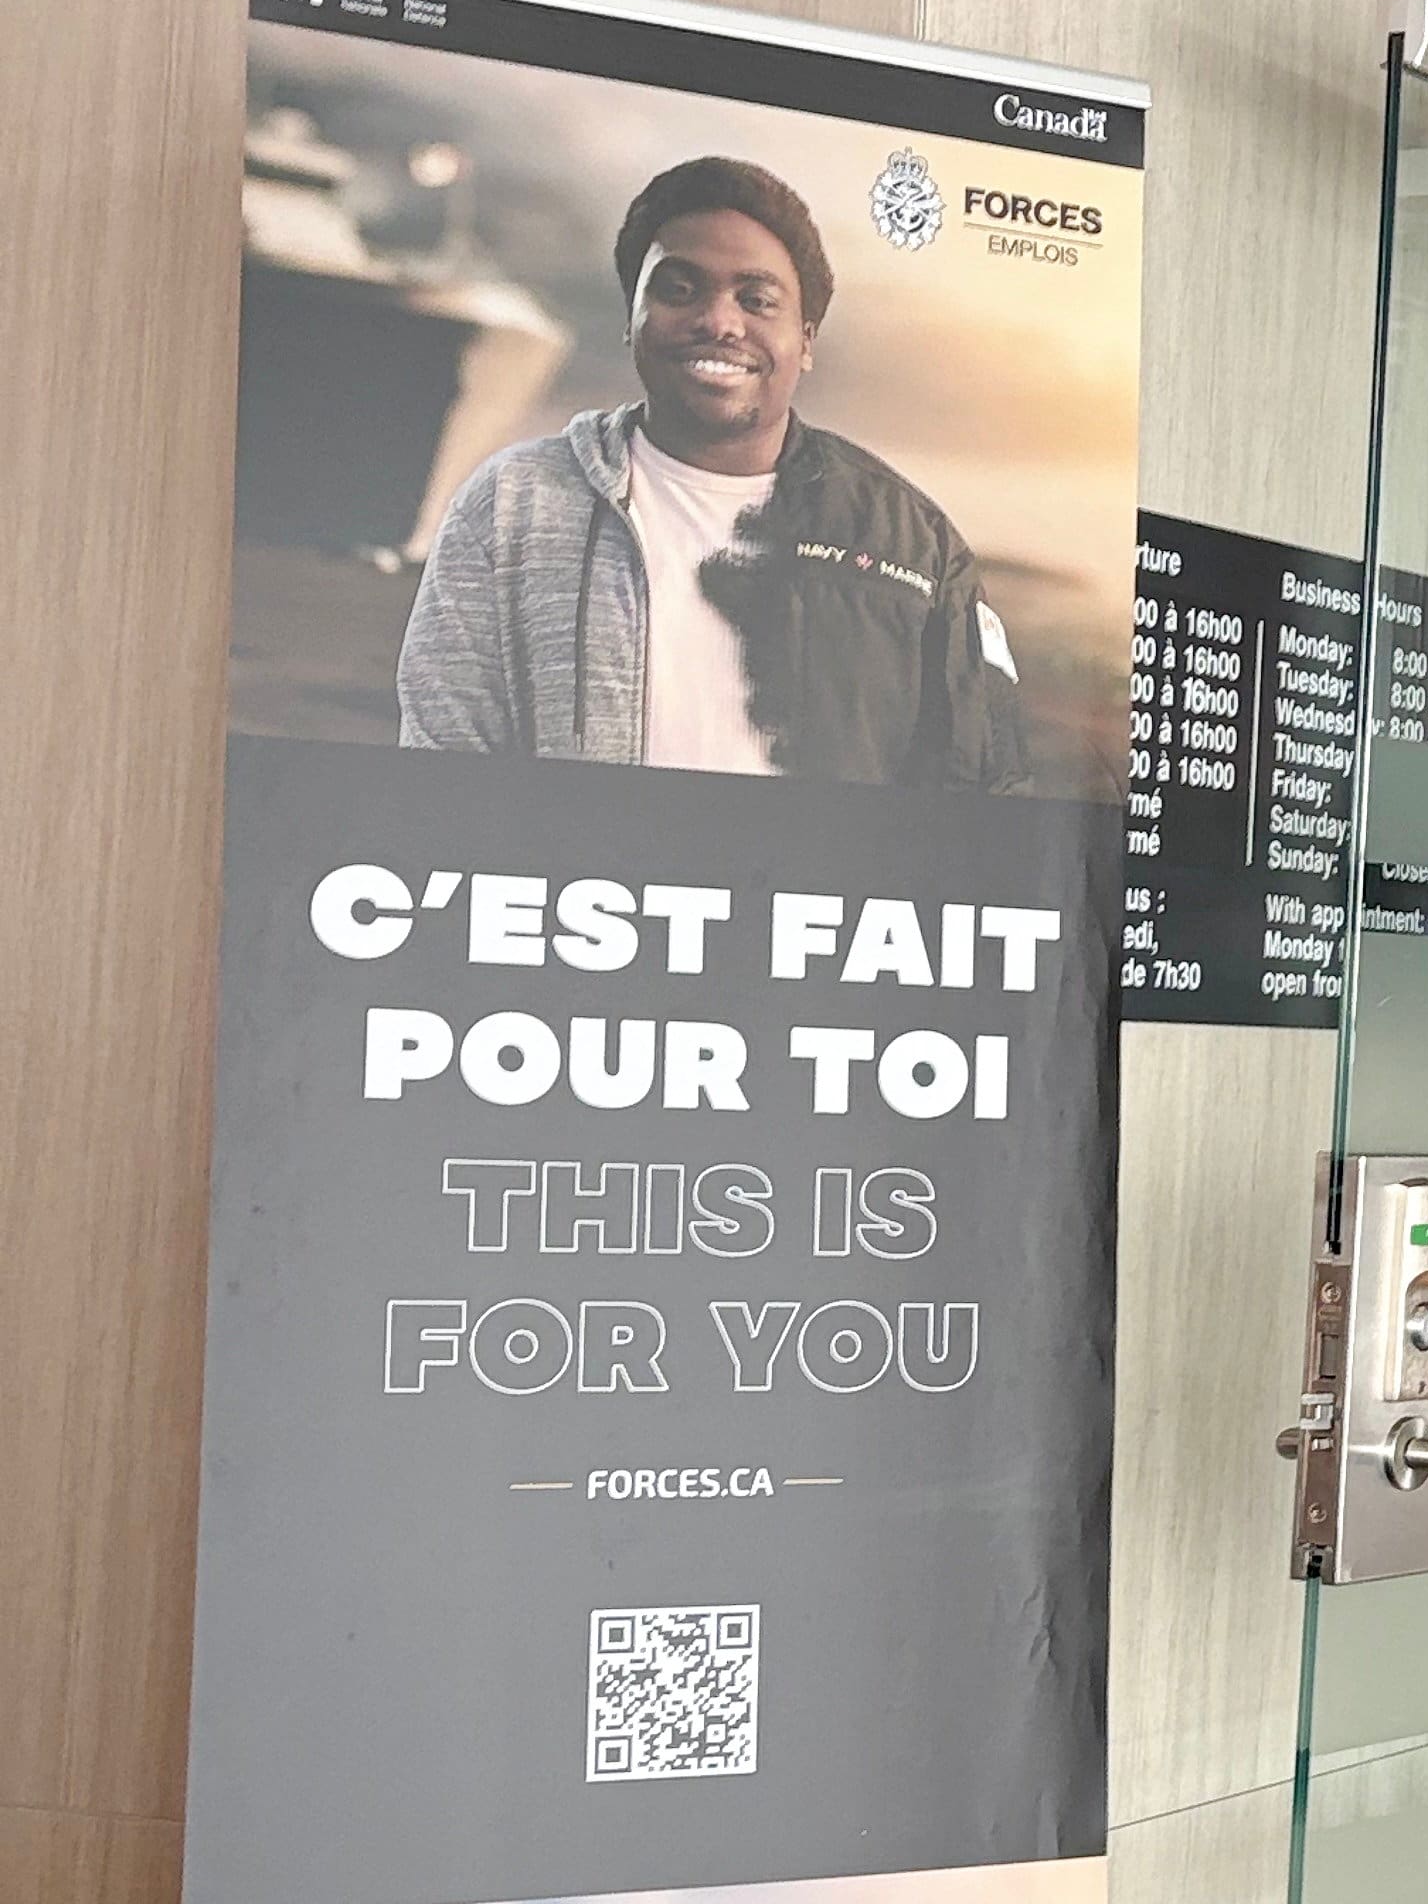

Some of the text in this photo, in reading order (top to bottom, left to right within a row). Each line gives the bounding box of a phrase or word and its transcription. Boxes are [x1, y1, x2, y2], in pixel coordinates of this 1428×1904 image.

[993, 93, 1109, 143] Canada
[964, 185, 1103, 235] FORCES
[988, 234, 1079, 267] EMPLOIS
[1136, 541, 1182, 576] rture
[1281, 571, 1361, 615] Business
[1134, 596, 1158, 629] 00
[1185, 607, 1243, 645] 16h00
[1132, 634, 1156, 666] 00
[1183, 644, 1241, 681] 16h00
[1278, 624, 1353, 672] Monday:
[1393, 647, 1427, 678] 8:00
[1130, 672, 1155, 704] 00
[1181, 676, 1239, 718] 16h00
[1276, 660, 1353, 707] Tuesday:
[1391, 681, 1425, 713] 8:00
[1129, 710, 1152, 742] 00
[1180, 719, 1237, 754] 16h00
[1389, 716, 1424, 743] 8:00
[1128, 748, 1150, 780] 00
[1178, 756, 1235, 791] 16h00
[1271, 768, 1331, 809] Friday:
[1128, 787, 1162, 818] mé
[1126, 824, 1161, 856] mé
[1267, 839, 1340, 881] Sunday:
[1125, 887, 1150, 912] us
[1265, 893, 1306, 925] With
[310, 863, 1061, 992] C'EST FAIT
[1123, 920, 1159, 955] edi,
[1263, 930, 1333, 968] Monday
[1121, 957, 1201, 991] de 7h30
[1261, 972, 1307, 1002] open
[363, 1008, 1010, 1119] POUR TOI
[442, 1158, 937, 1259] THIS IS
[383, 1297, 979, 1394] FOR YOU
[586, 1467, 775, 1498] FORCES.CA
